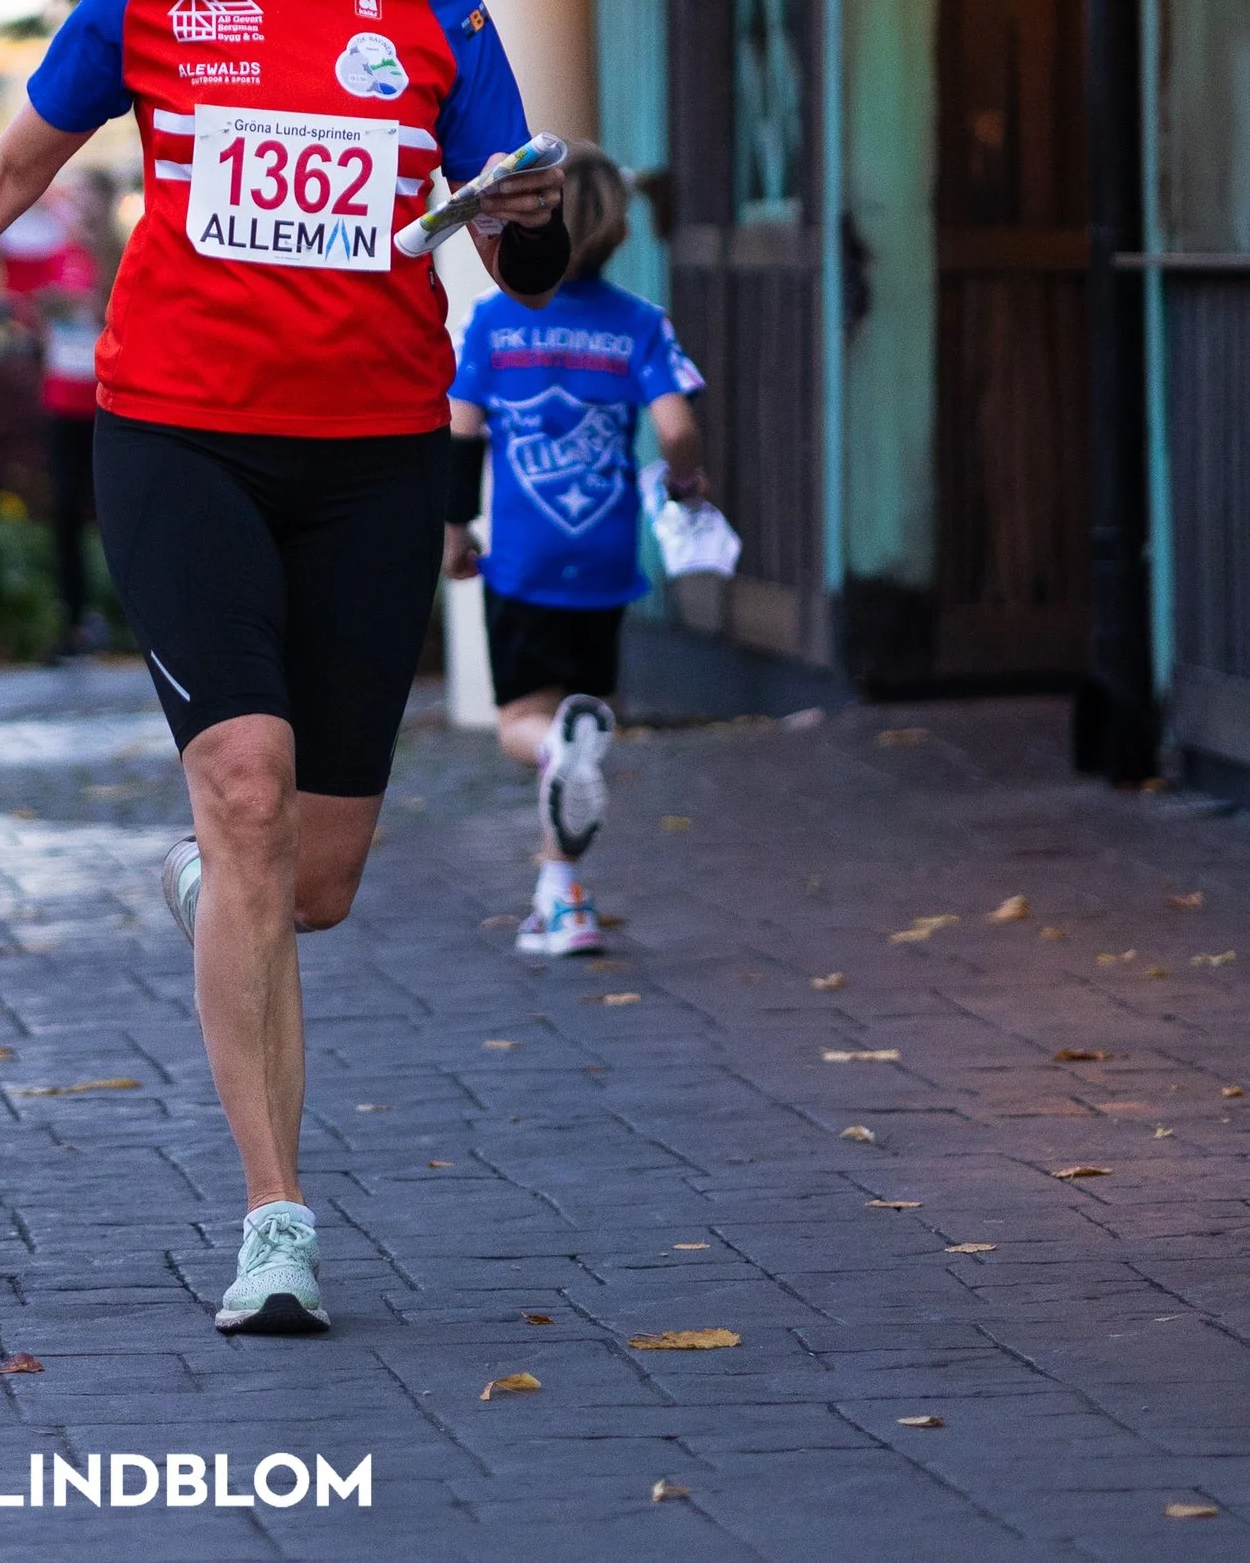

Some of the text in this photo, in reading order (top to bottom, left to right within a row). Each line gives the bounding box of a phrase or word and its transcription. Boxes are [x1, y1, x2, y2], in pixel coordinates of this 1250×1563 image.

[178, 60, 261, 78] ALEWALDS
[191, 75, 223, 86] OUTDOOR
[231, 75, 261, 84] SPORTS
[234, 119, 361, 141] Gröna Lund-sprinten
[219, 136, 373, 217] 1362
[200, 212, 378, 262] ALLEMAN
